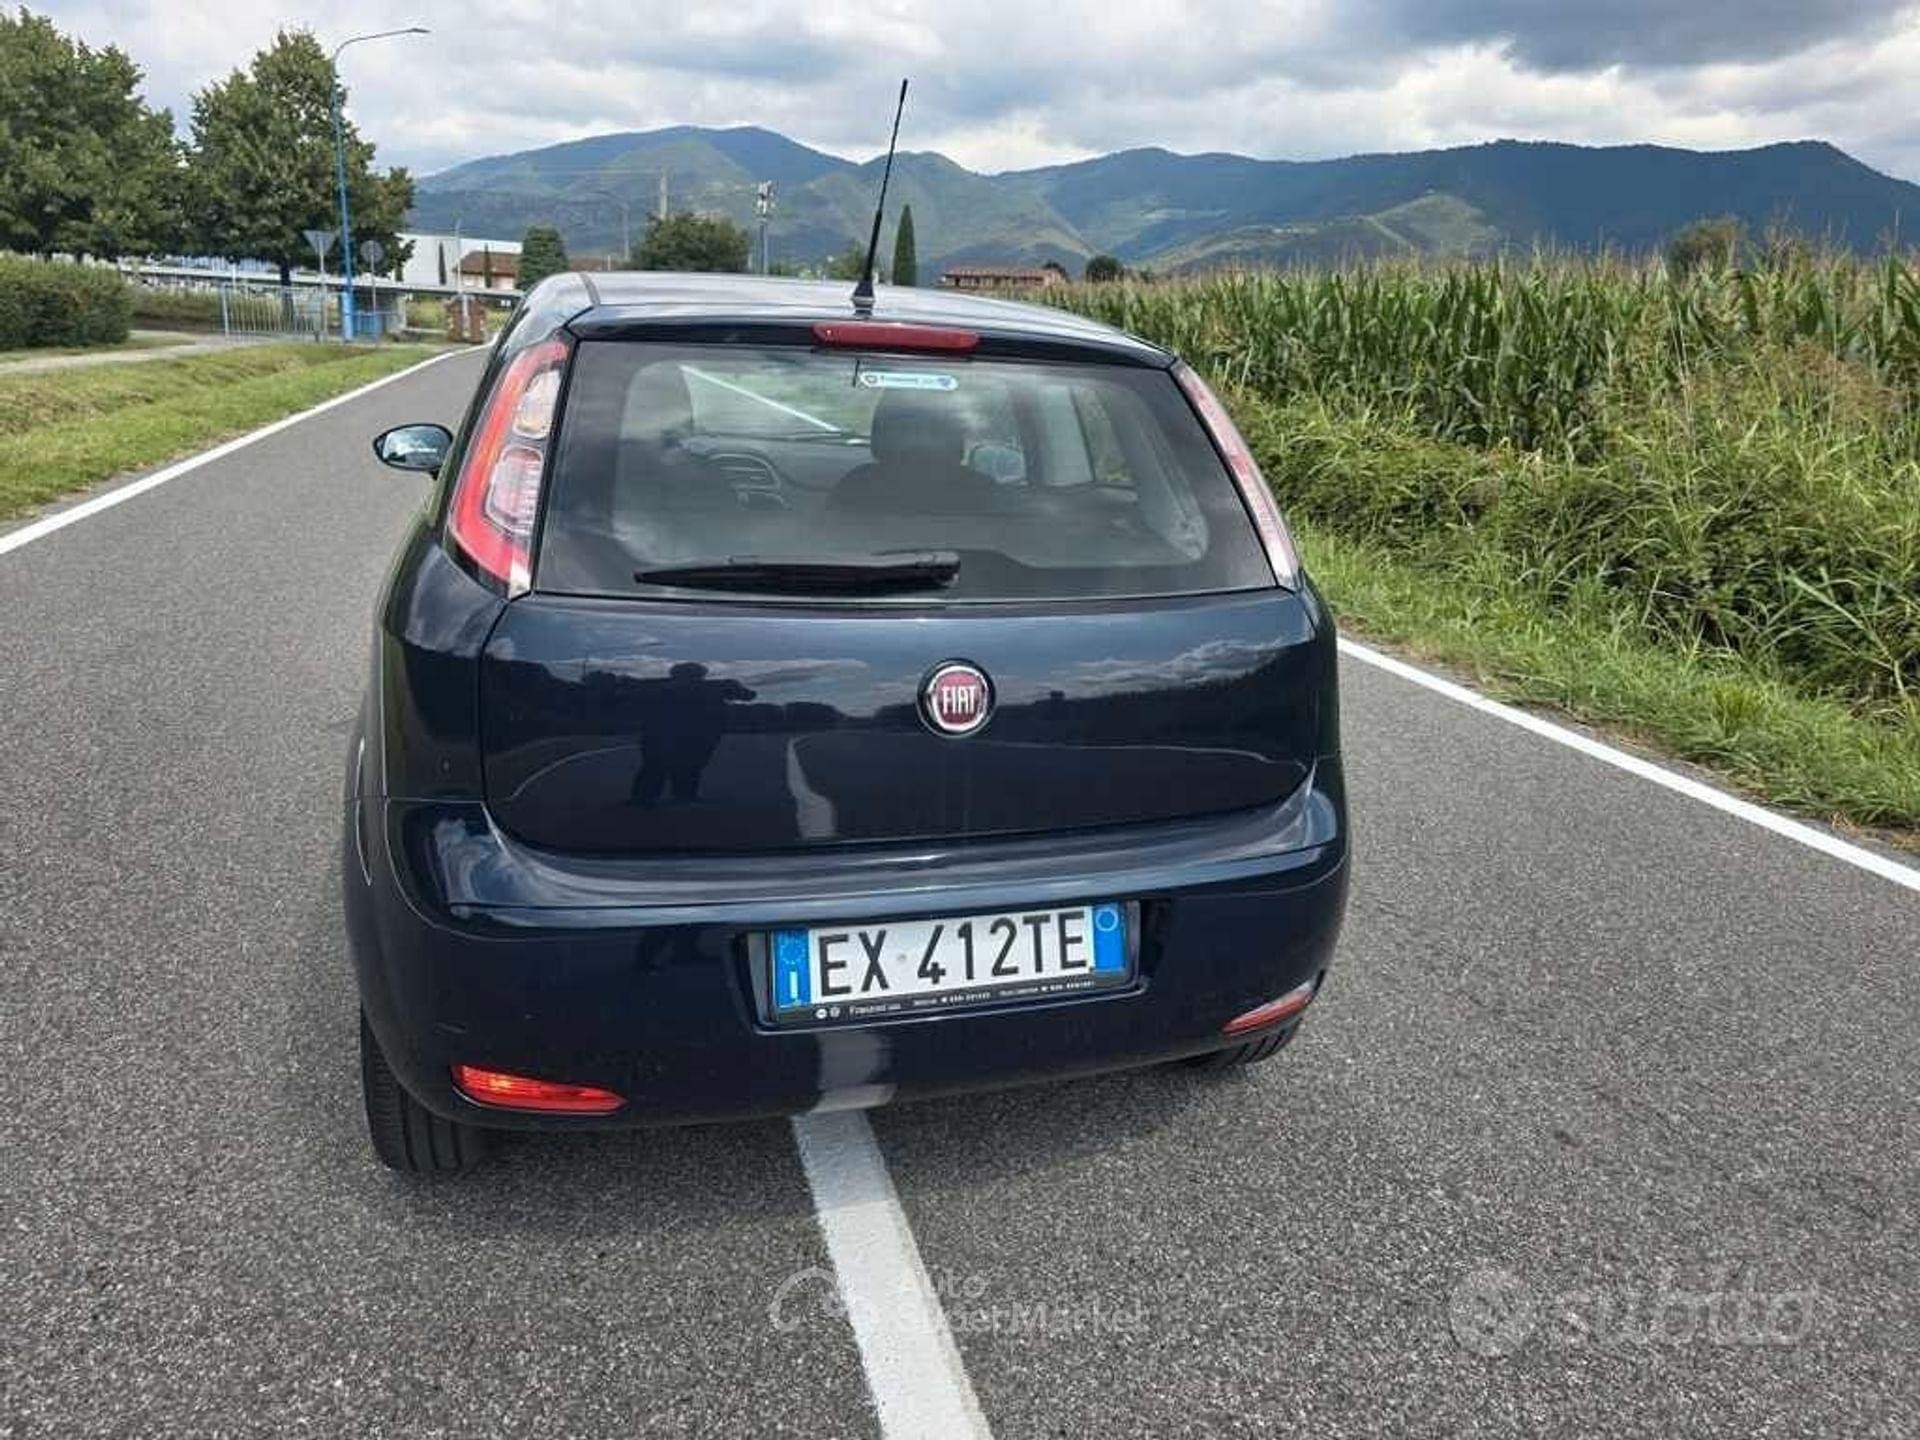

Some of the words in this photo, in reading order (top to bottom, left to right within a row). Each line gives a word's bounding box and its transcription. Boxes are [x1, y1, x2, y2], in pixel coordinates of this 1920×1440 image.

[941, 686, 976, 714] FIAT
[819, 930, 889, 997] EX
[917, 911, 1088, 985] 412TE
